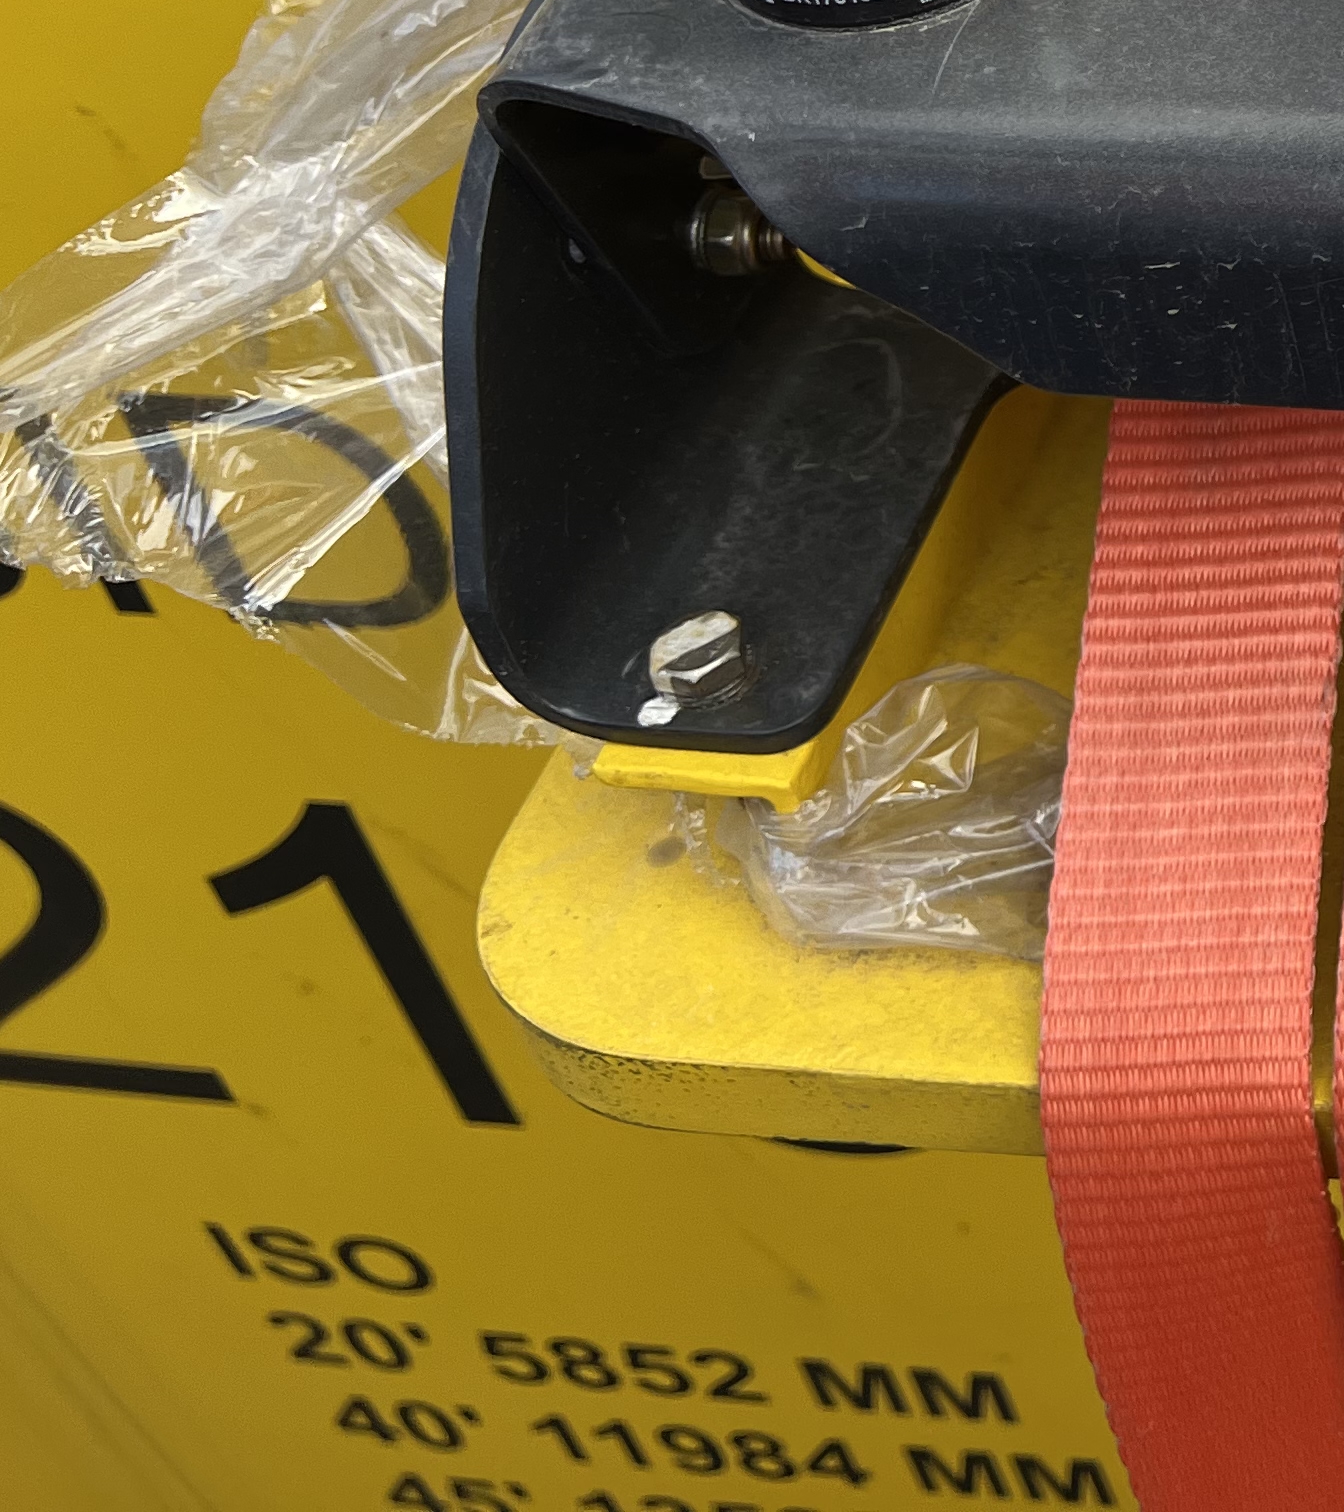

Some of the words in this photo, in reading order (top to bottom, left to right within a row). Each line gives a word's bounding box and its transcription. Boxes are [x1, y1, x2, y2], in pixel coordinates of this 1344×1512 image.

[203, 1221, 434, 1296] ISO
[268, 1310, 432, 1372] 20'
[481, 1331, 769, 1403] 5852
[796, 1356, 1023, 1425] MM
[335, 1394, 482, 1453] 40'
[534, 1414, 868, 1486] 11984
[906, 1444, 1117, 1510] MM
